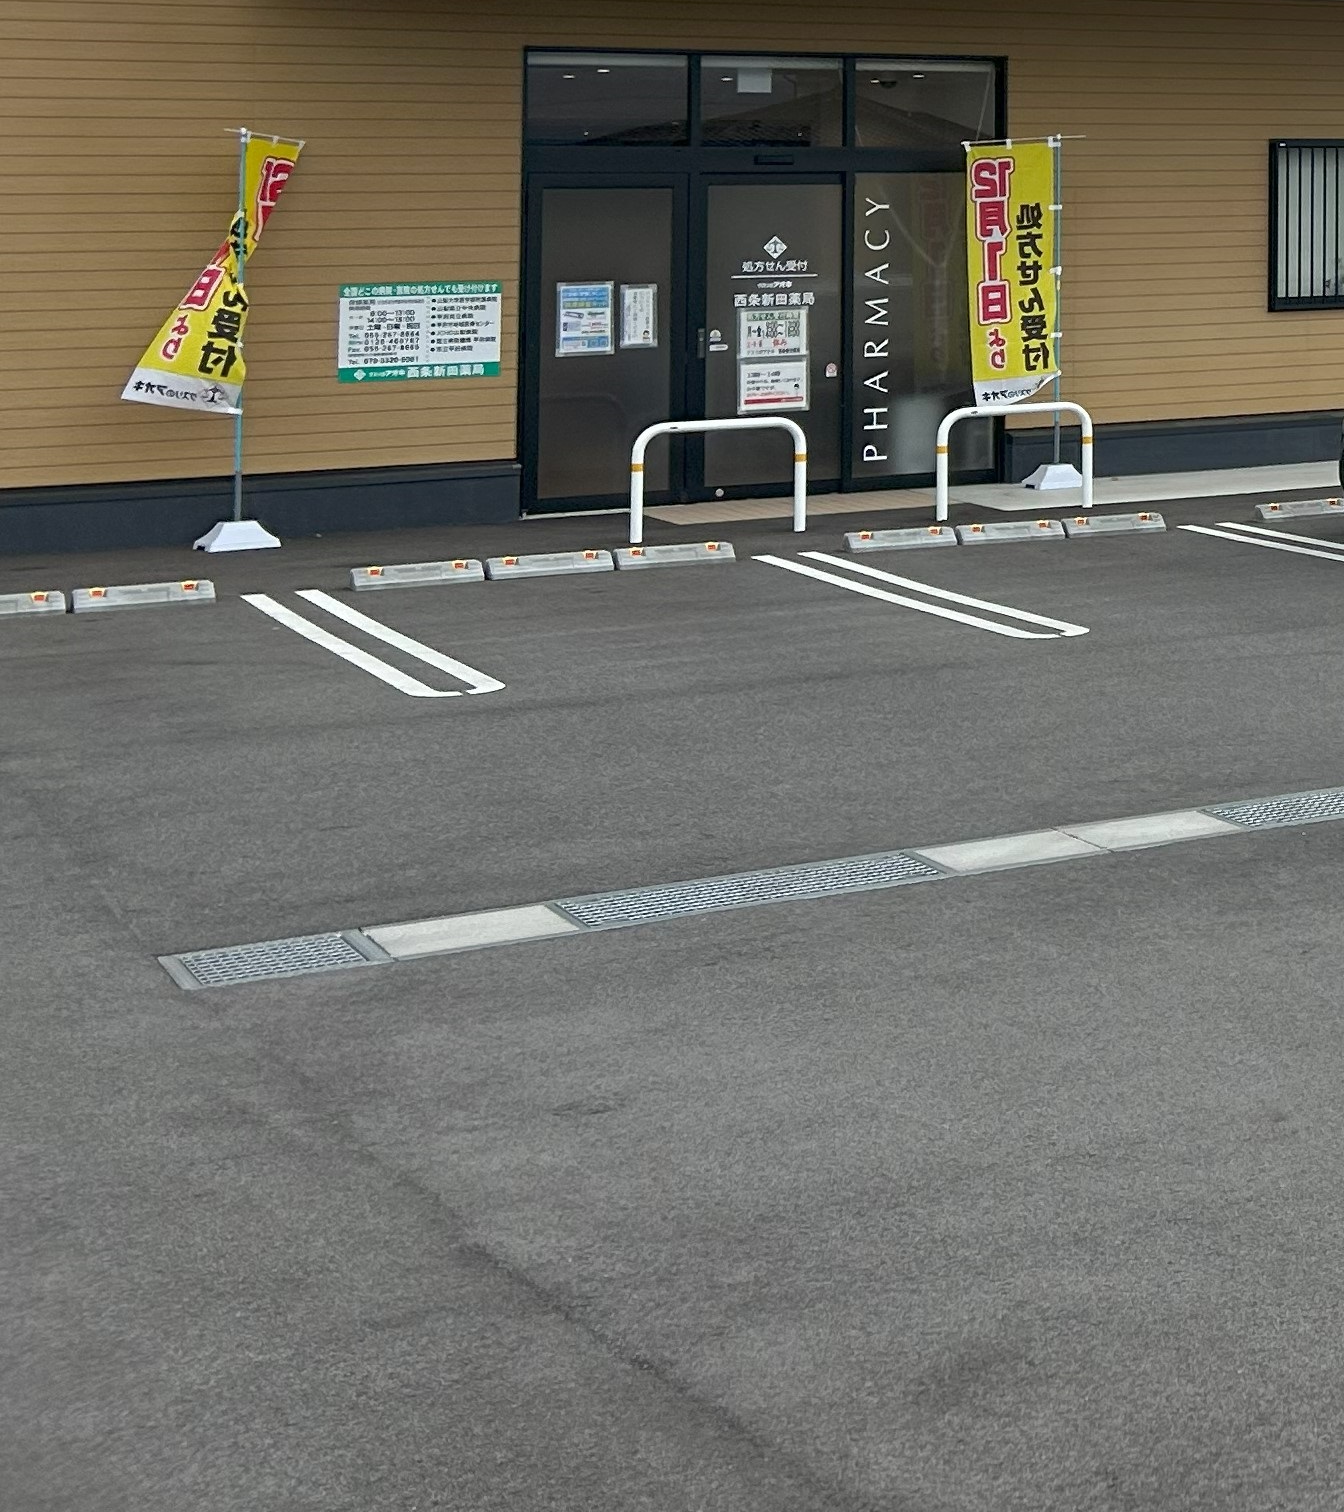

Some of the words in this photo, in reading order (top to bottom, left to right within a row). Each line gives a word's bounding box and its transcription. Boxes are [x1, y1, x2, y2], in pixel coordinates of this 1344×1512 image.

[742, 260, 808, 272] 処方せん受付
[734, 292, 815, 307] 西条新田薬局
[864, 197, 890, 462] PHARMACY
